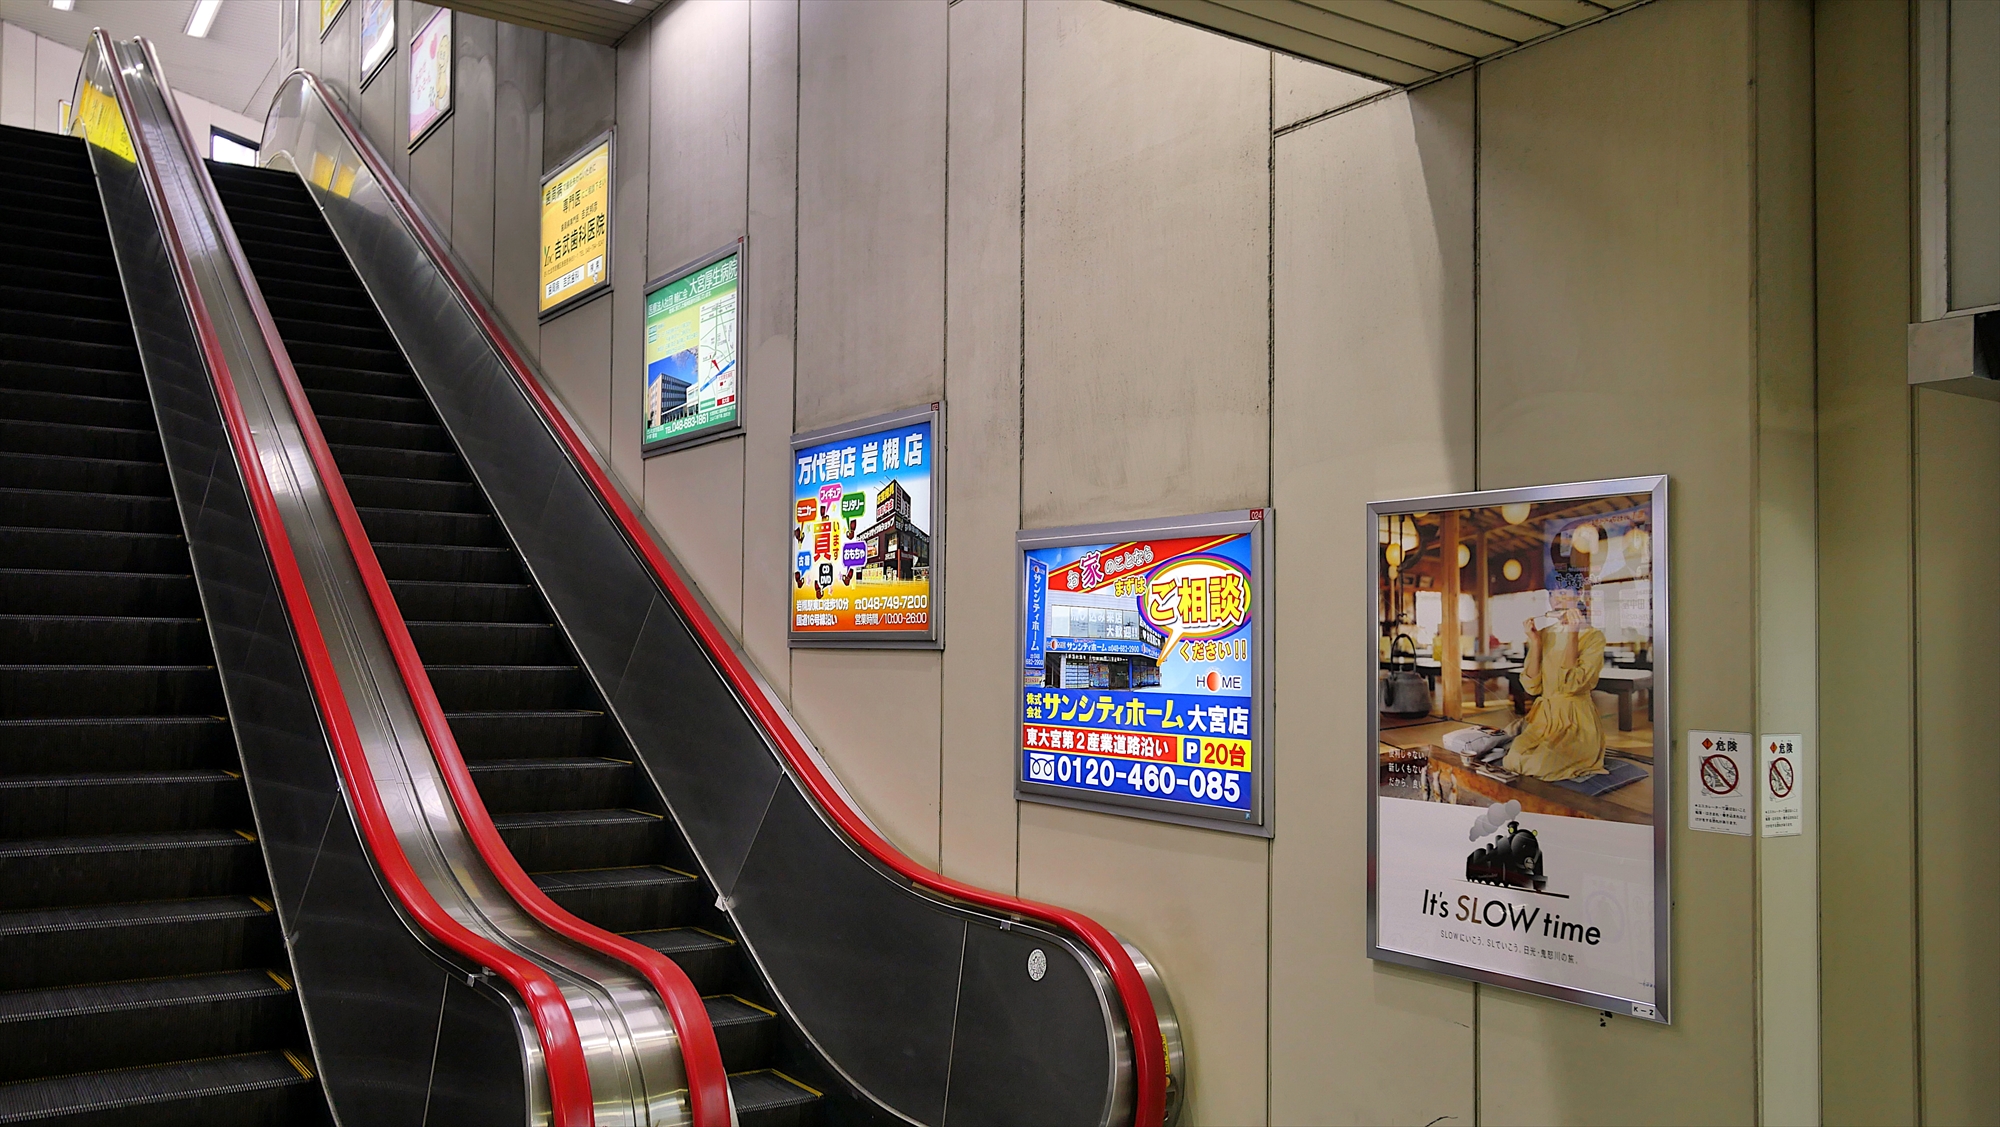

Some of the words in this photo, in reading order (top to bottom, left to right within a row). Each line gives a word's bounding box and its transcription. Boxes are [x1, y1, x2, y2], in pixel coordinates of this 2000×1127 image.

[689, 255, 737, 297] 大宮厚生病院
[798, 446, 857, 486] 万代書店
[1250, 510, 1263, 520] 024
[813, 521, 832, 563] 買
[843, 548, 866, 561] おもちゃ
[1067, 545, 1154, 589] お家のことなら
[1114, 576, 1146, 597] まずは
[862, 595, 928, 610] 048-749-7200
[1030, 573, 1042, 652] サンシティホーム
[1149, 572, 1243, 625] ご相談
[1043, 693, 1184, 729] サンシティホーム
[1187, 704, 1249, 736] 大宮店
[1026, 727, 1169, 758] 東大宮第2産業道路沿い
[1204, 742, 1246, 768] 20台
[1715, 739, 1738, 752] 危険
[1778, 742, 1793, 754] 危険
[1057, 755, 1241, 803] 0120-460-085
[1422, 888, 1449, 918] It's
[1455, 894, 1540, 934] SLOW
[1543, 912, 1601, 946] time
